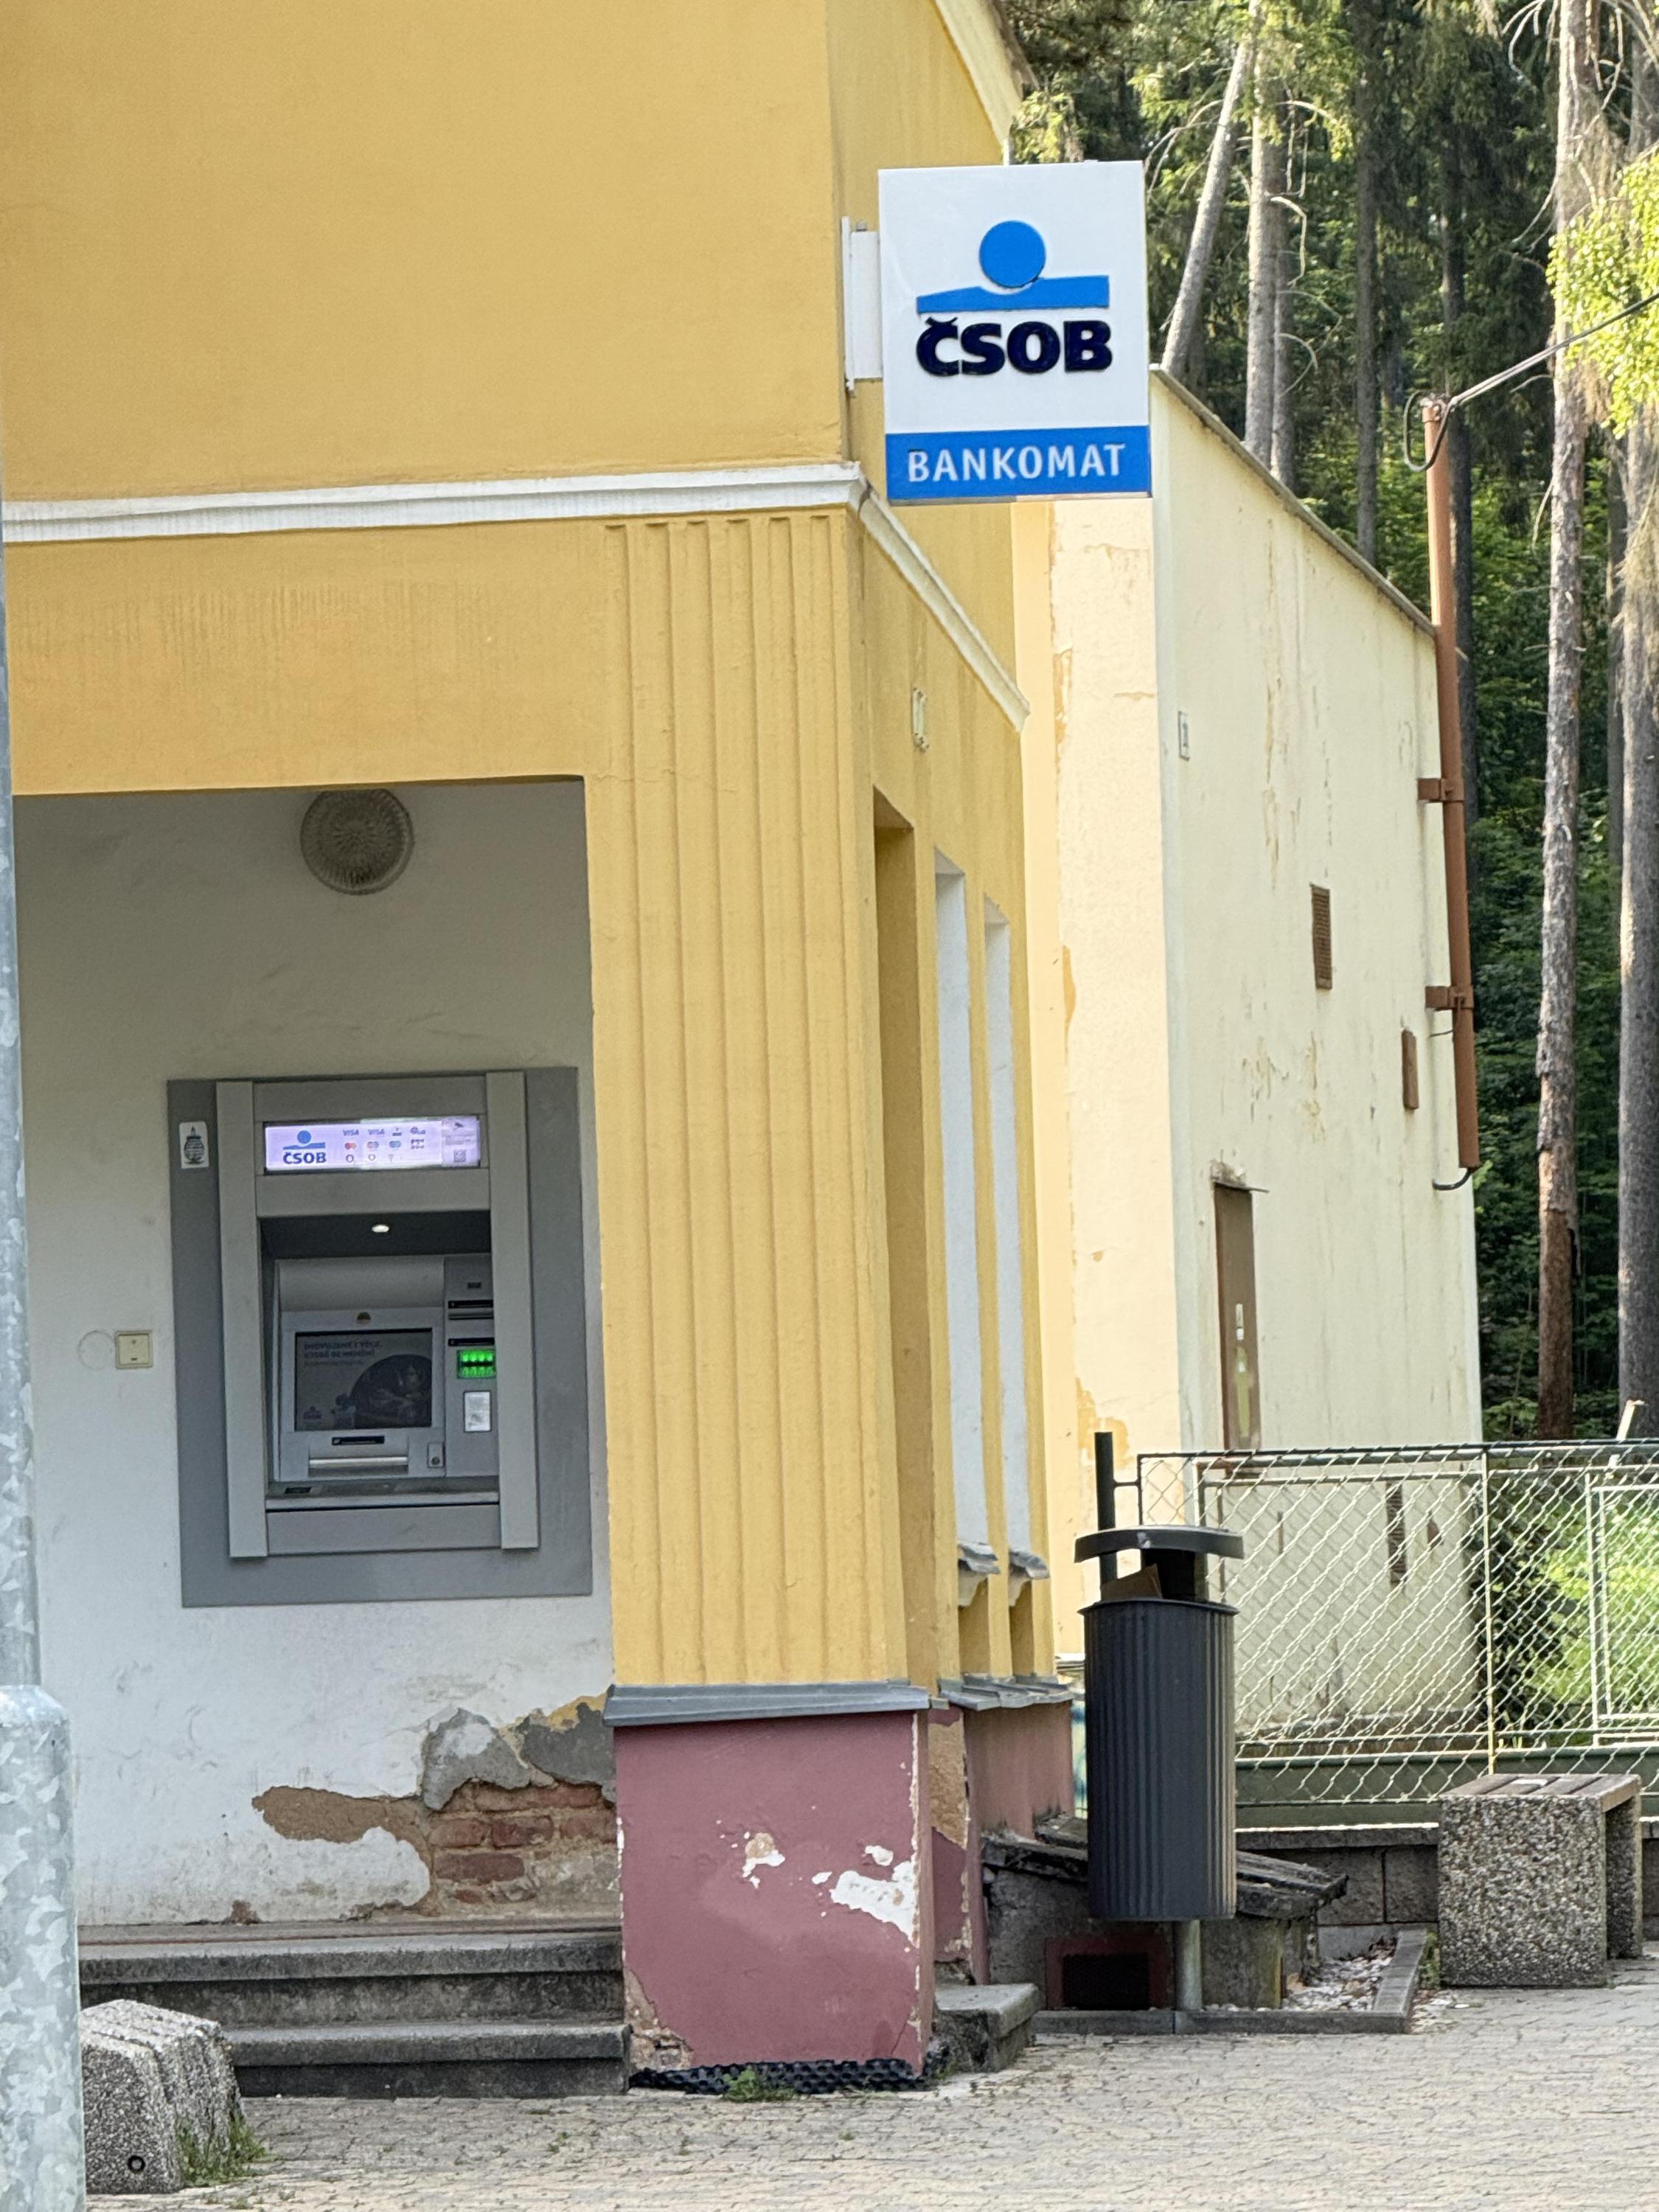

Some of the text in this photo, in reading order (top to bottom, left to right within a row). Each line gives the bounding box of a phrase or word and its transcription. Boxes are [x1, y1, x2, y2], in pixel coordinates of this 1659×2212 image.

[916, 317, 1113, 377] ČSOB
[908, 444, 1125, 482] BANKOMAT
[282, 1152, 327, 1164] ČSOB
